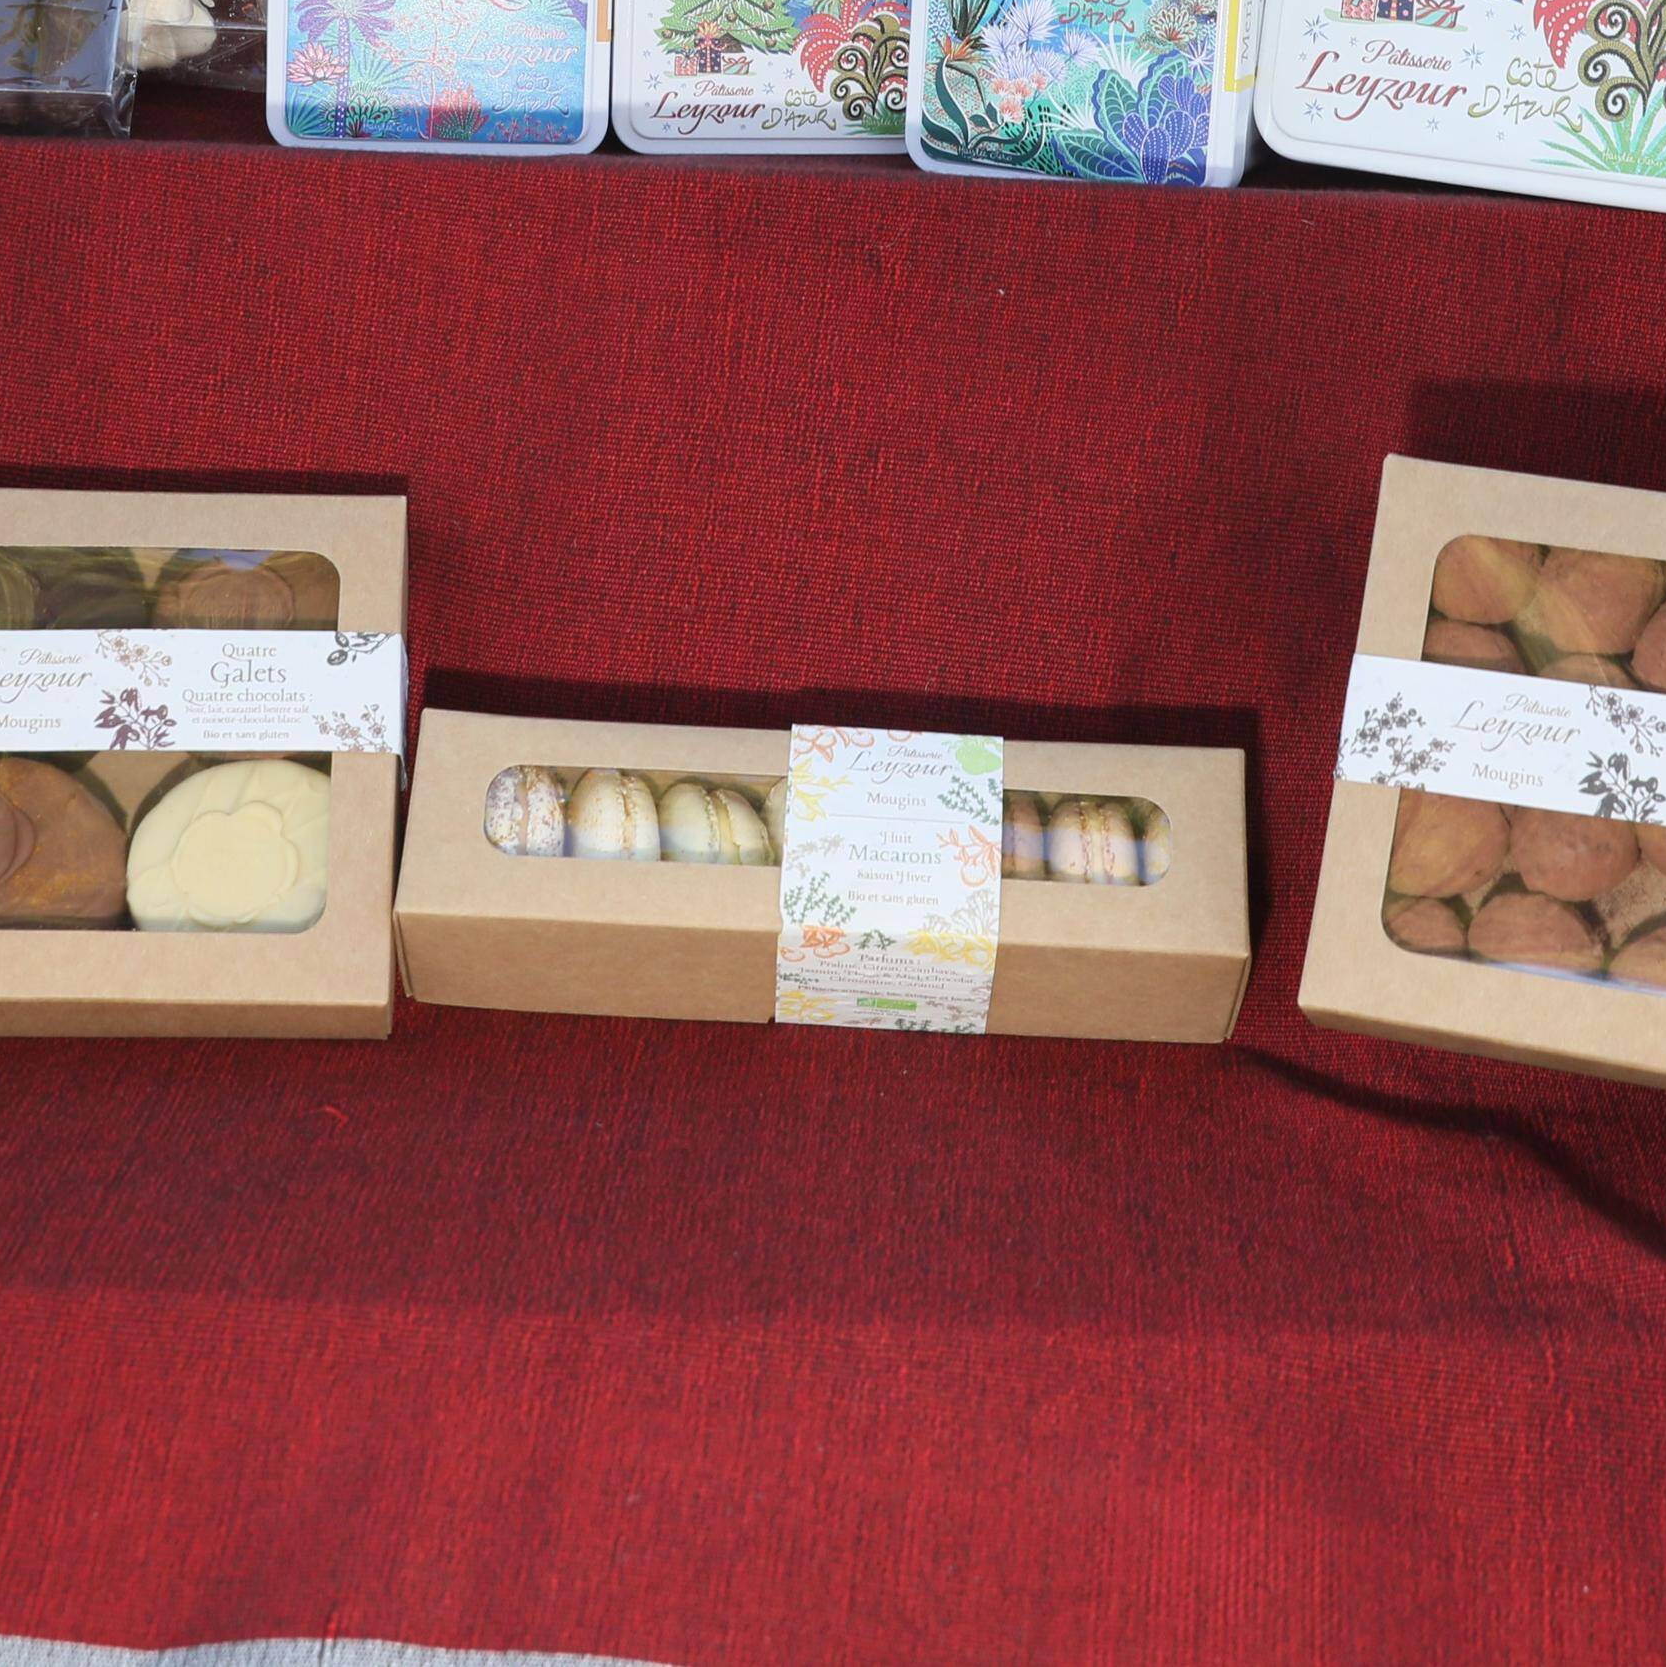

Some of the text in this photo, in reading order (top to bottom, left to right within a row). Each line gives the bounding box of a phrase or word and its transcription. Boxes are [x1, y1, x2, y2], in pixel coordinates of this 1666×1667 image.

[460, 30, 580, 77] Leyzour
[1361, 38, 1453, 72] Pâtisserie
[1506, 57, 1579, 92] Côte
[693, 79, 754, 97] Pâtisserie
[1295, 50, 1468, 121] Leyzour
[784, 88, 832, 109] Côte
[649, 91, 765, 134] Leyzour
[18, 648, 82, 666] Pâtisserie
[222, 642, 277, 661] Quatre
[210, 659, 287, 689] Galets
[182, 688, 233, 706] Quatre
[237, 688, 306, 702] chocolats
[1503, 693, 1572, 718] Pâtisserie
[203, 729, 289, 741] Bio et sans gluten
[1451, 700, 1581, 752] Leyzour
[887, 745, 943, 760] Pâtisserie
[847, 750, 953, 784] Leyzour
[1472, 762, 1544, 790] Mougins
[867, 792, 927, 810] Mougins
[879, 830, 912, 845] Huit
[848, 844, 942, 865] Macarons
[857, 868, 893, 881] Saison
[848, 890, 939, 906] Bio et sans gluten
[860, 953, 916, 965] Parfums
